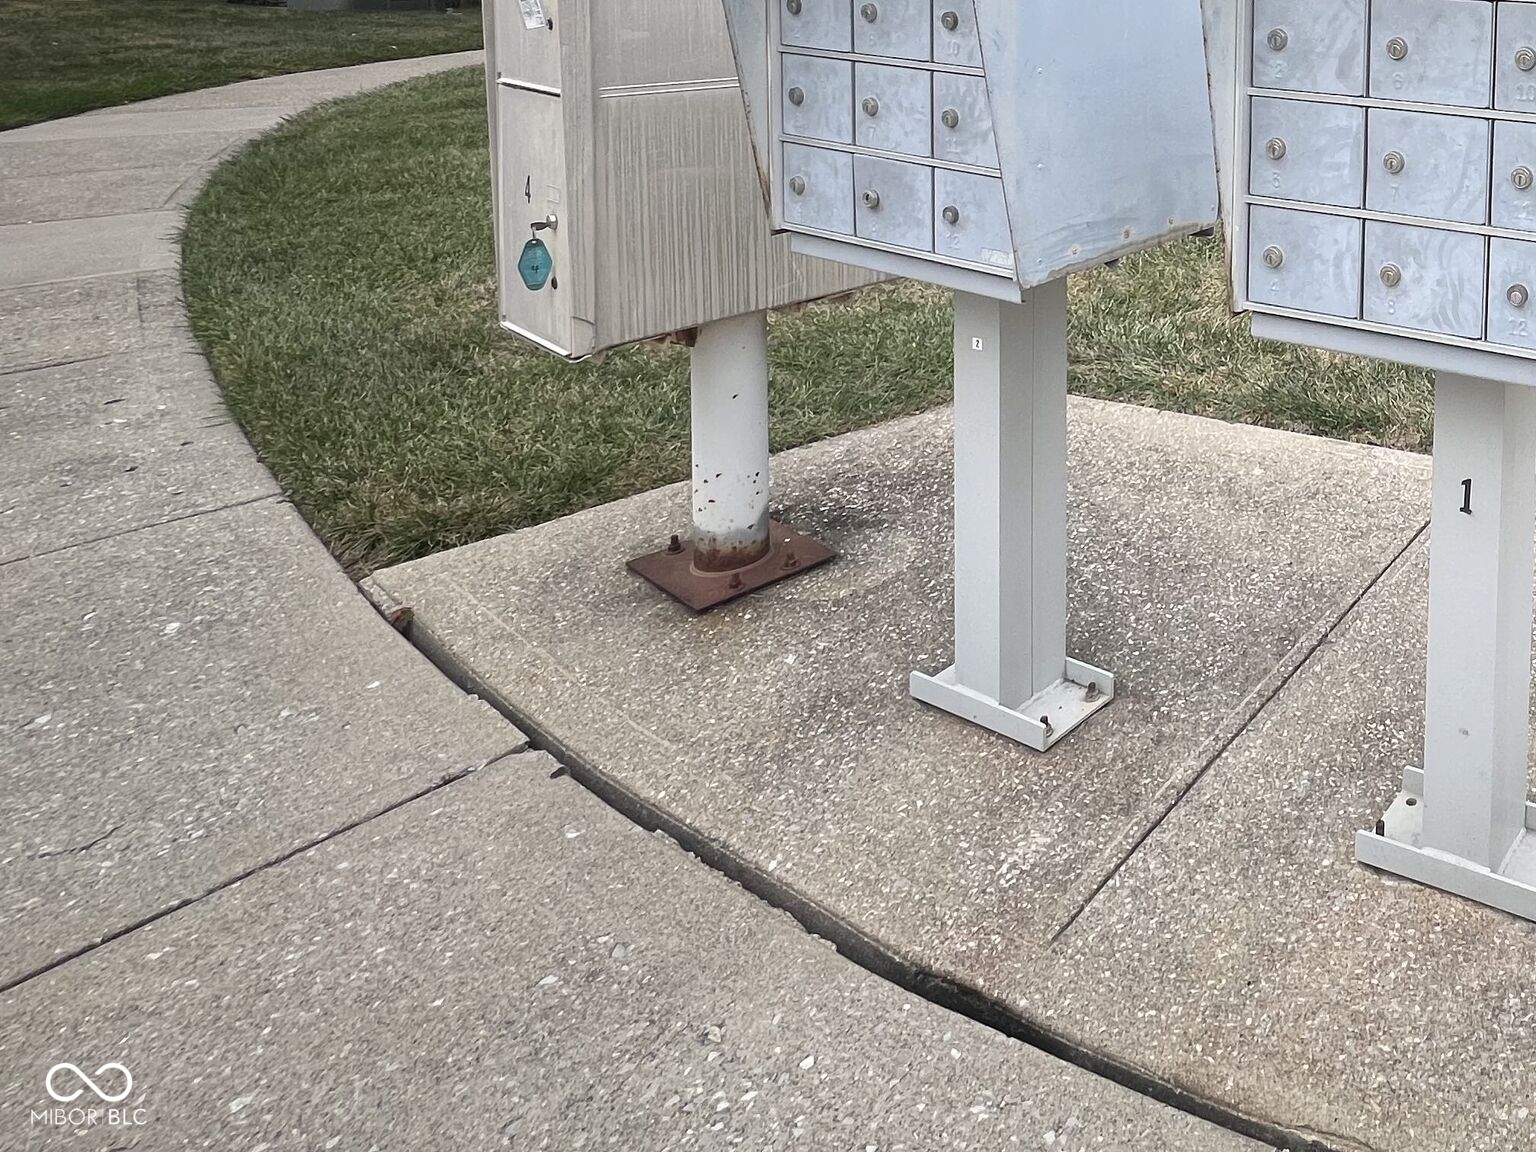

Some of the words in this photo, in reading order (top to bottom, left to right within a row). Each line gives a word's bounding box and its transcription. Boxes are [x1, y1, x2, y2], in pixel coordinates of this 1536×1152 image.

[1274, 61, 1283, 78] 2
[1393, 73, 1402, 90] 6
[1515, 83, 1536, 102] 10
[524, 175, 531, 203] 4
[1390, 183, 1399, 203] 7
[1508, 317, 1528, 337] 12
[975, 339, 980, 348] 2
[1460, 478, 1472, 516] 1
